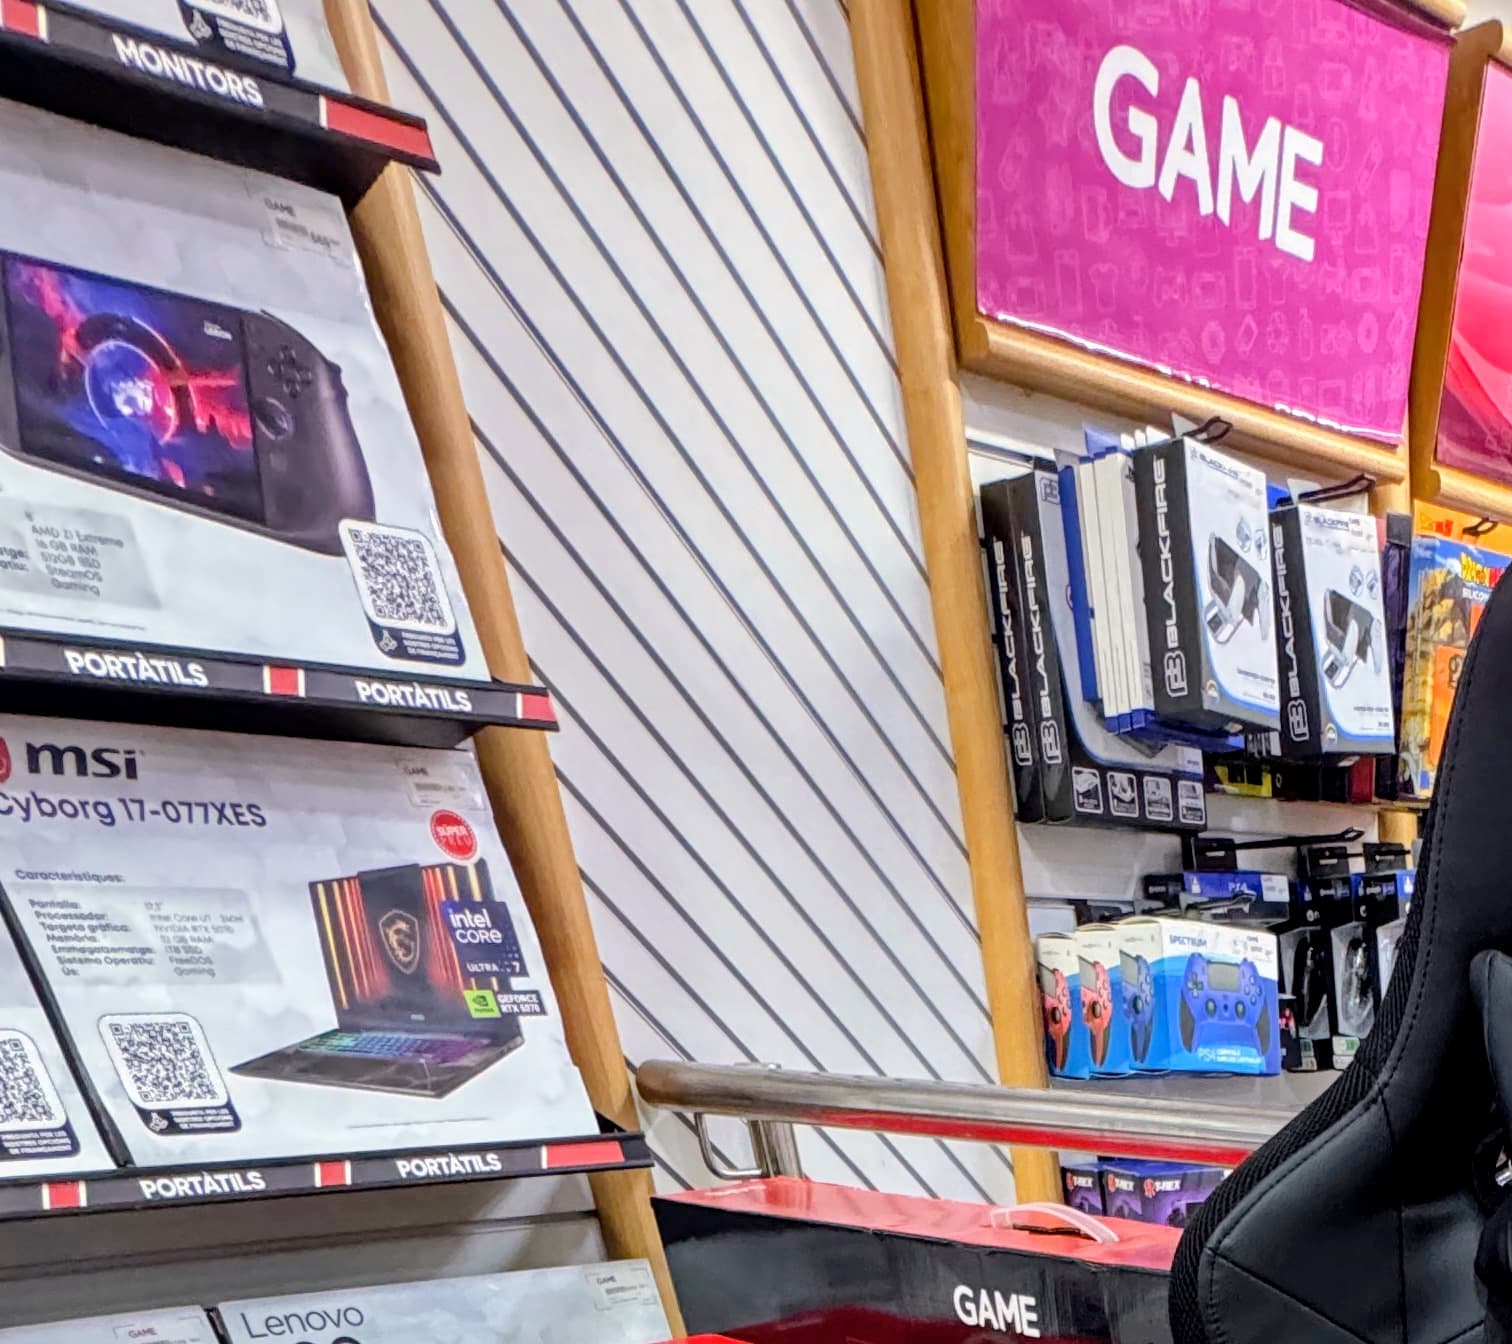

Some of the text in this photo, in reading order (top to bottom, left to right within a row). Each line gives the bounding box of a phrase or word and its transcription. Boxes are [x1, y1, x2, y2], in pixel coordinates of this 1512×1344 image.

[112, 34, 264, 110] MONITORS
[1094, 44, 1323, 262] GAME
[1152, 454, 1178, 649] BLACKFIRE
[1020, 531, 1053, 720] BLACKFIRE
[1271, 520, 1302, 700] BLACKFIRE
[65, 646, 209, 689] PORTÀTILS
[355, 680, 473, 712] PORTÀTILS
[26, 741, 138, 780] msi
[117, 796, 268, 828] 17-077XES
[449, 907, 491, 928] intel
[138, 1170, 267, 1199] PORTÀTILS
[395, 1152, 502, 1178] PORTÀTILS
[241, 1304, 365, 1340] Lenovo
[953, 1284, 1041, 1338] GAME
